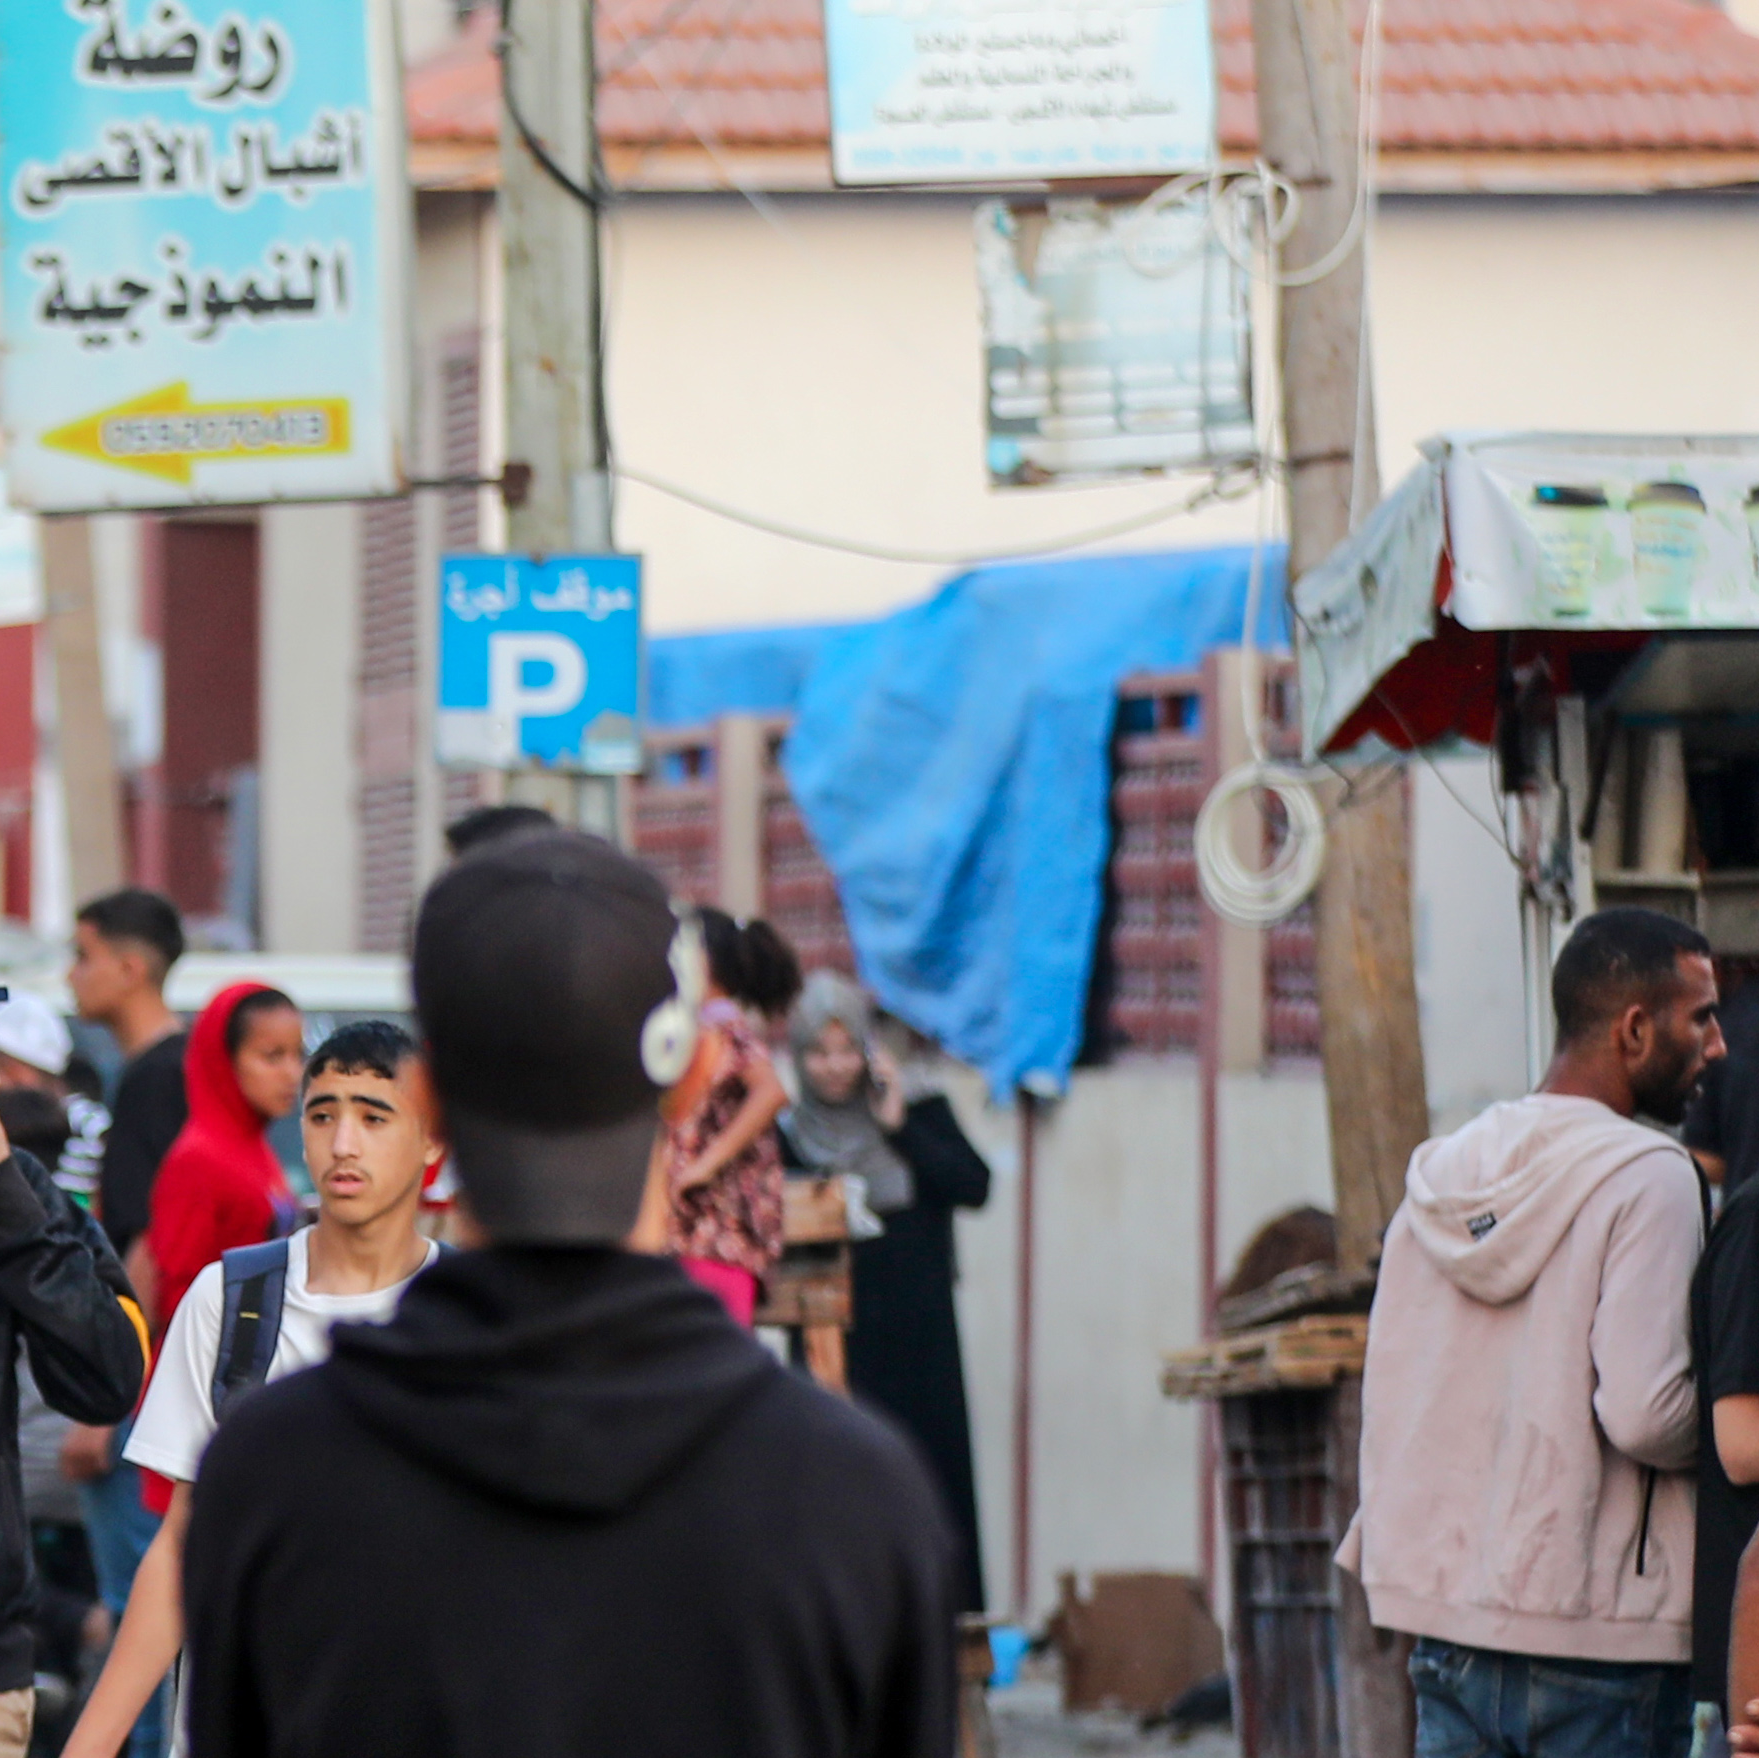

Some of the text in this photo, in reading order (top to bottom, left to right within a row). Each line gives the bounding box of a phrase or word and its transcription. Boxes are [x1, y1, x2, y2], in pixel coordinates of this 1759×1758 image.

[78, 0, 280, 99] روضة
[32, 243, 346, 346] النموذجية
[488, 631, 589, 760] P
